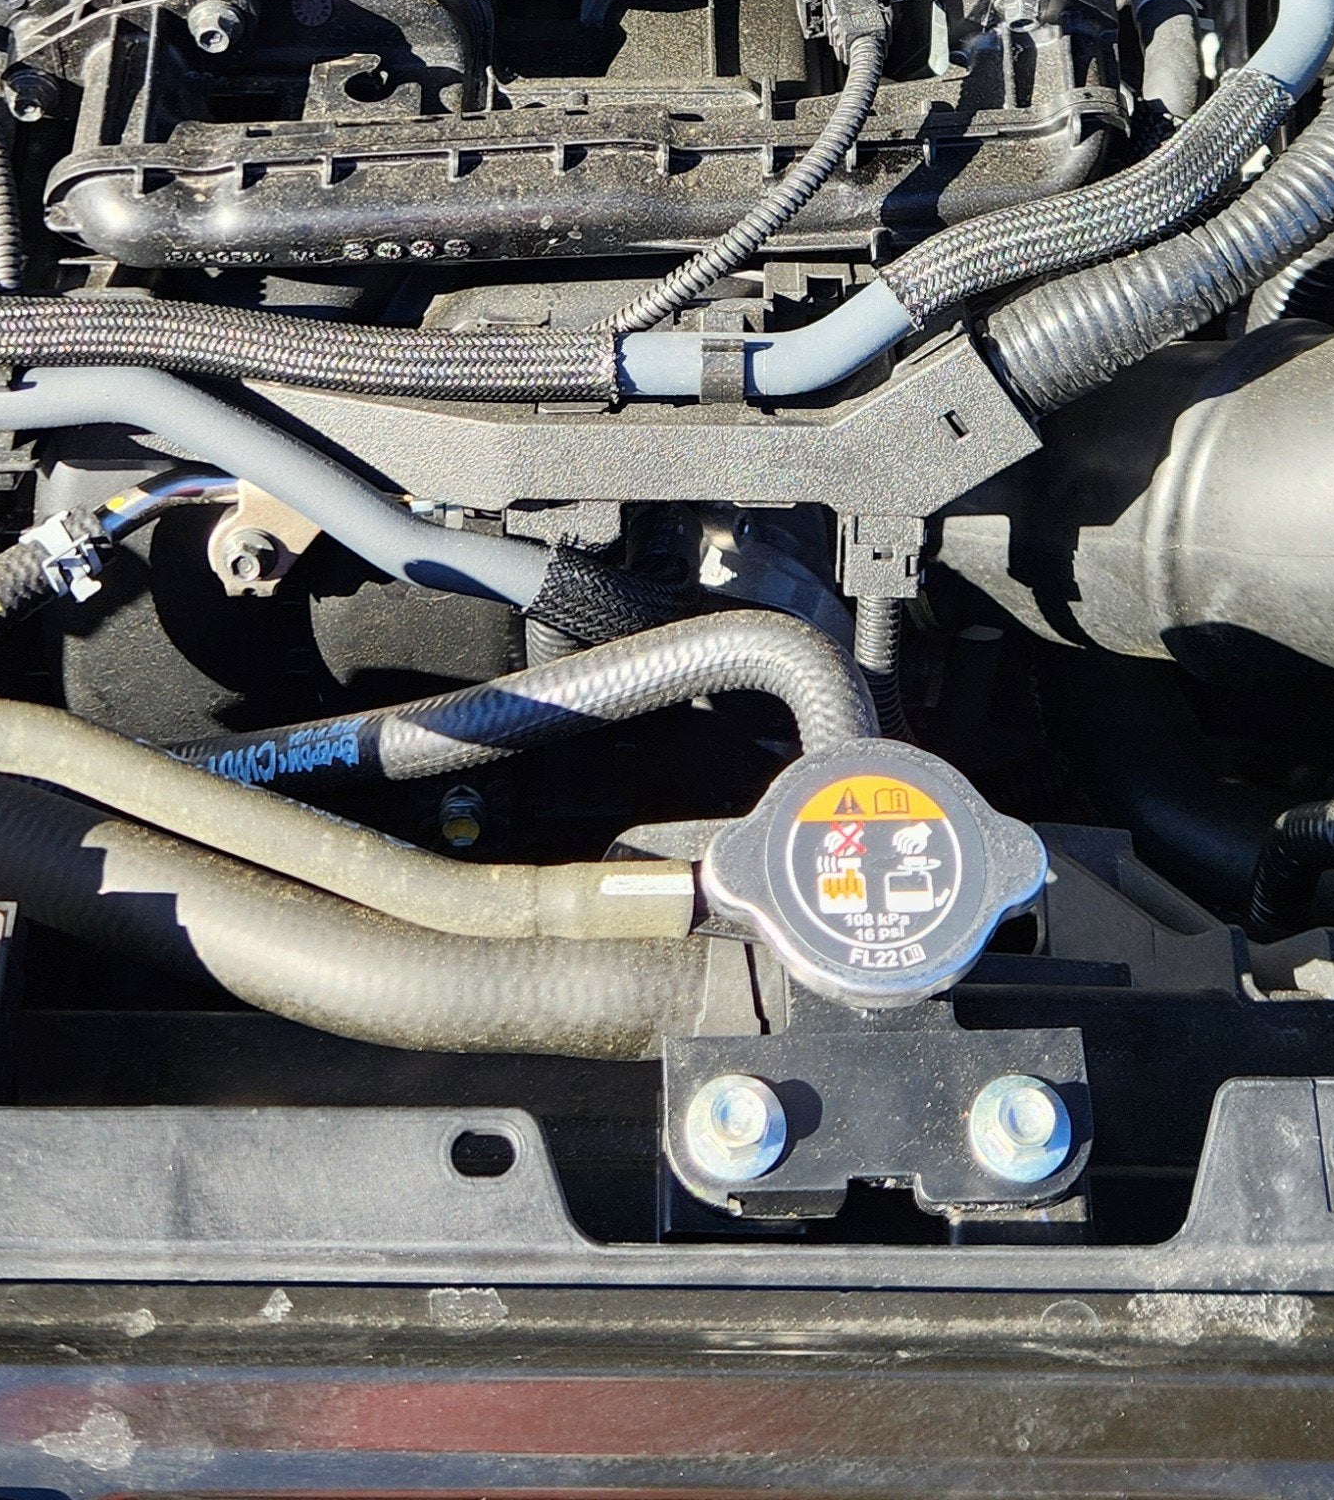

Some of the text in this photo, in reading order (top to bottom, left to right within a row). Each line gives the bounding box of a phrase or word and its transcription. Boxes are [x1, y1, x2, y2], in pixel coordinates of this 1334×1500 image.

[843, 912, 911, 928] 108 kPa
[853, 924, 906, 942] 16 psi
[849, 947, 900, 969] FL22
